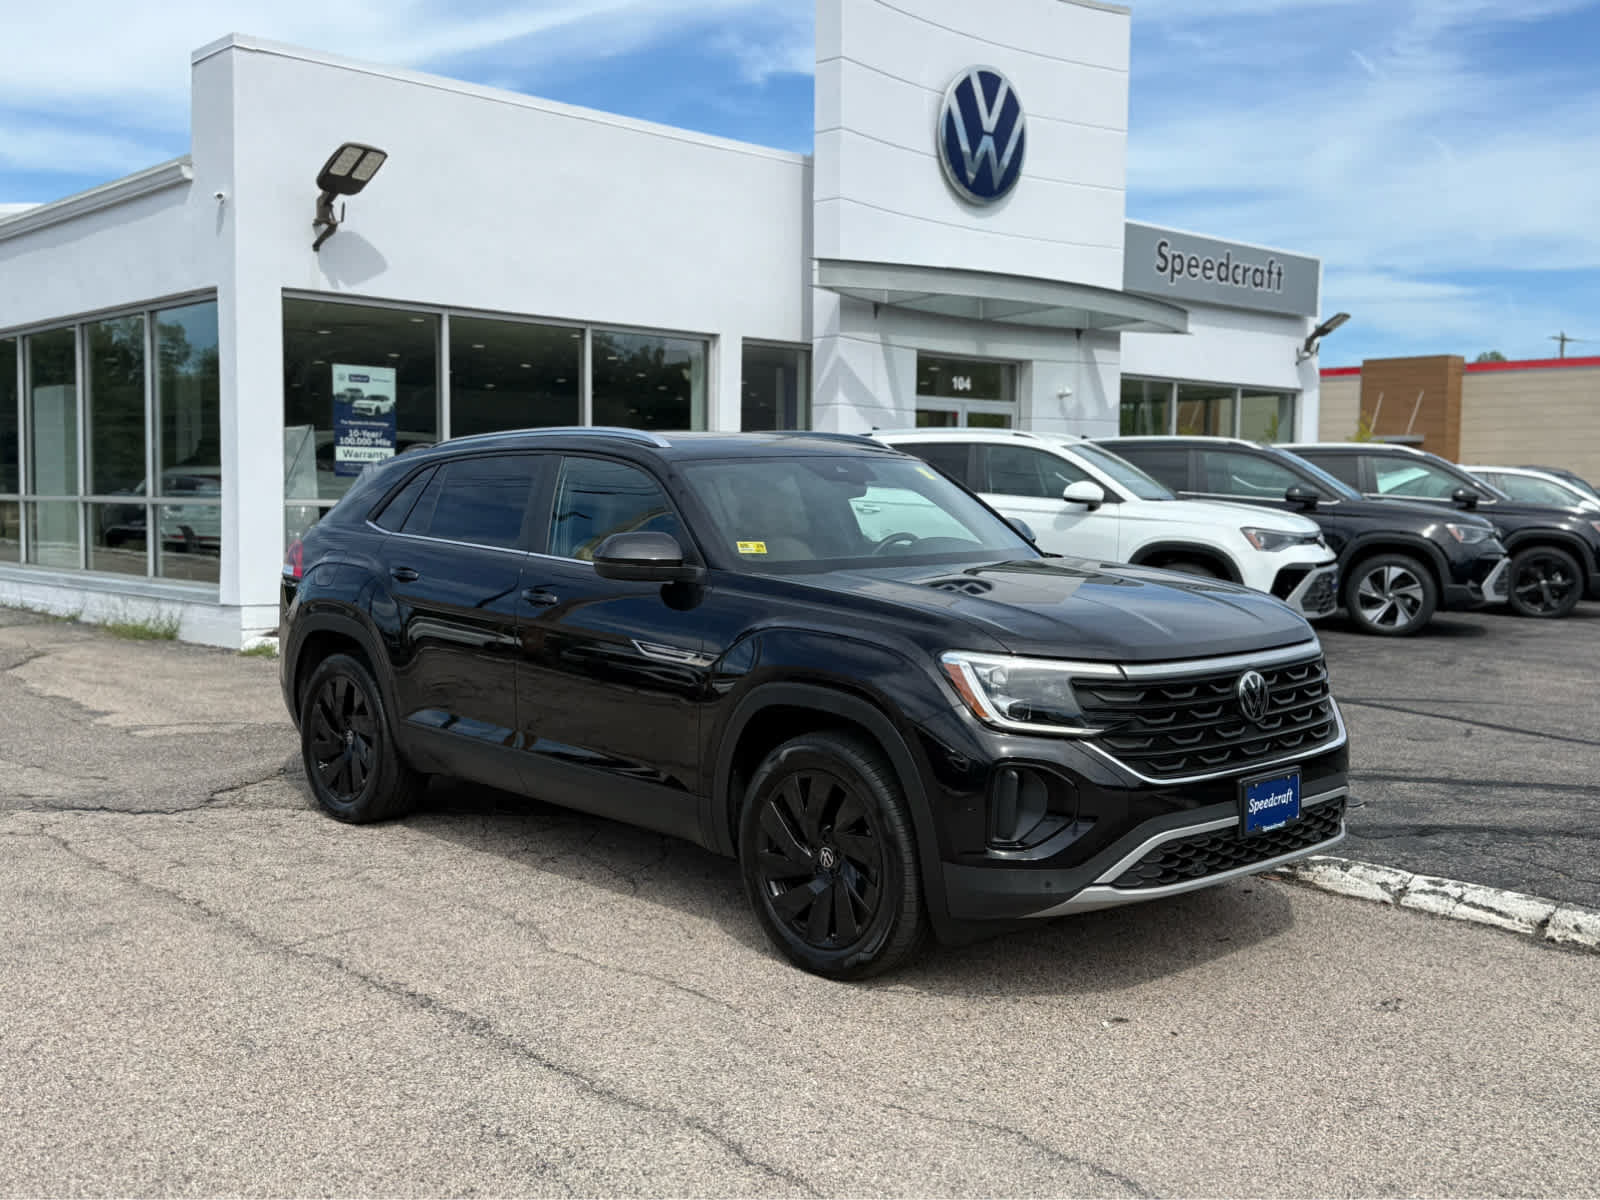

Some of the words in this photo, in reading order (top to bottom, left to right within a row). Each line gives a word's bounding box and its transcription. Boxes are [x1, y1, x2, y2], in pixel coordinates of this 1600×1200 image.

[1155, 240, 1284, 291] Speedcraft
[951, 375, 972, 391] 104
[1248, 787, 1294, 815] Speedcraft
